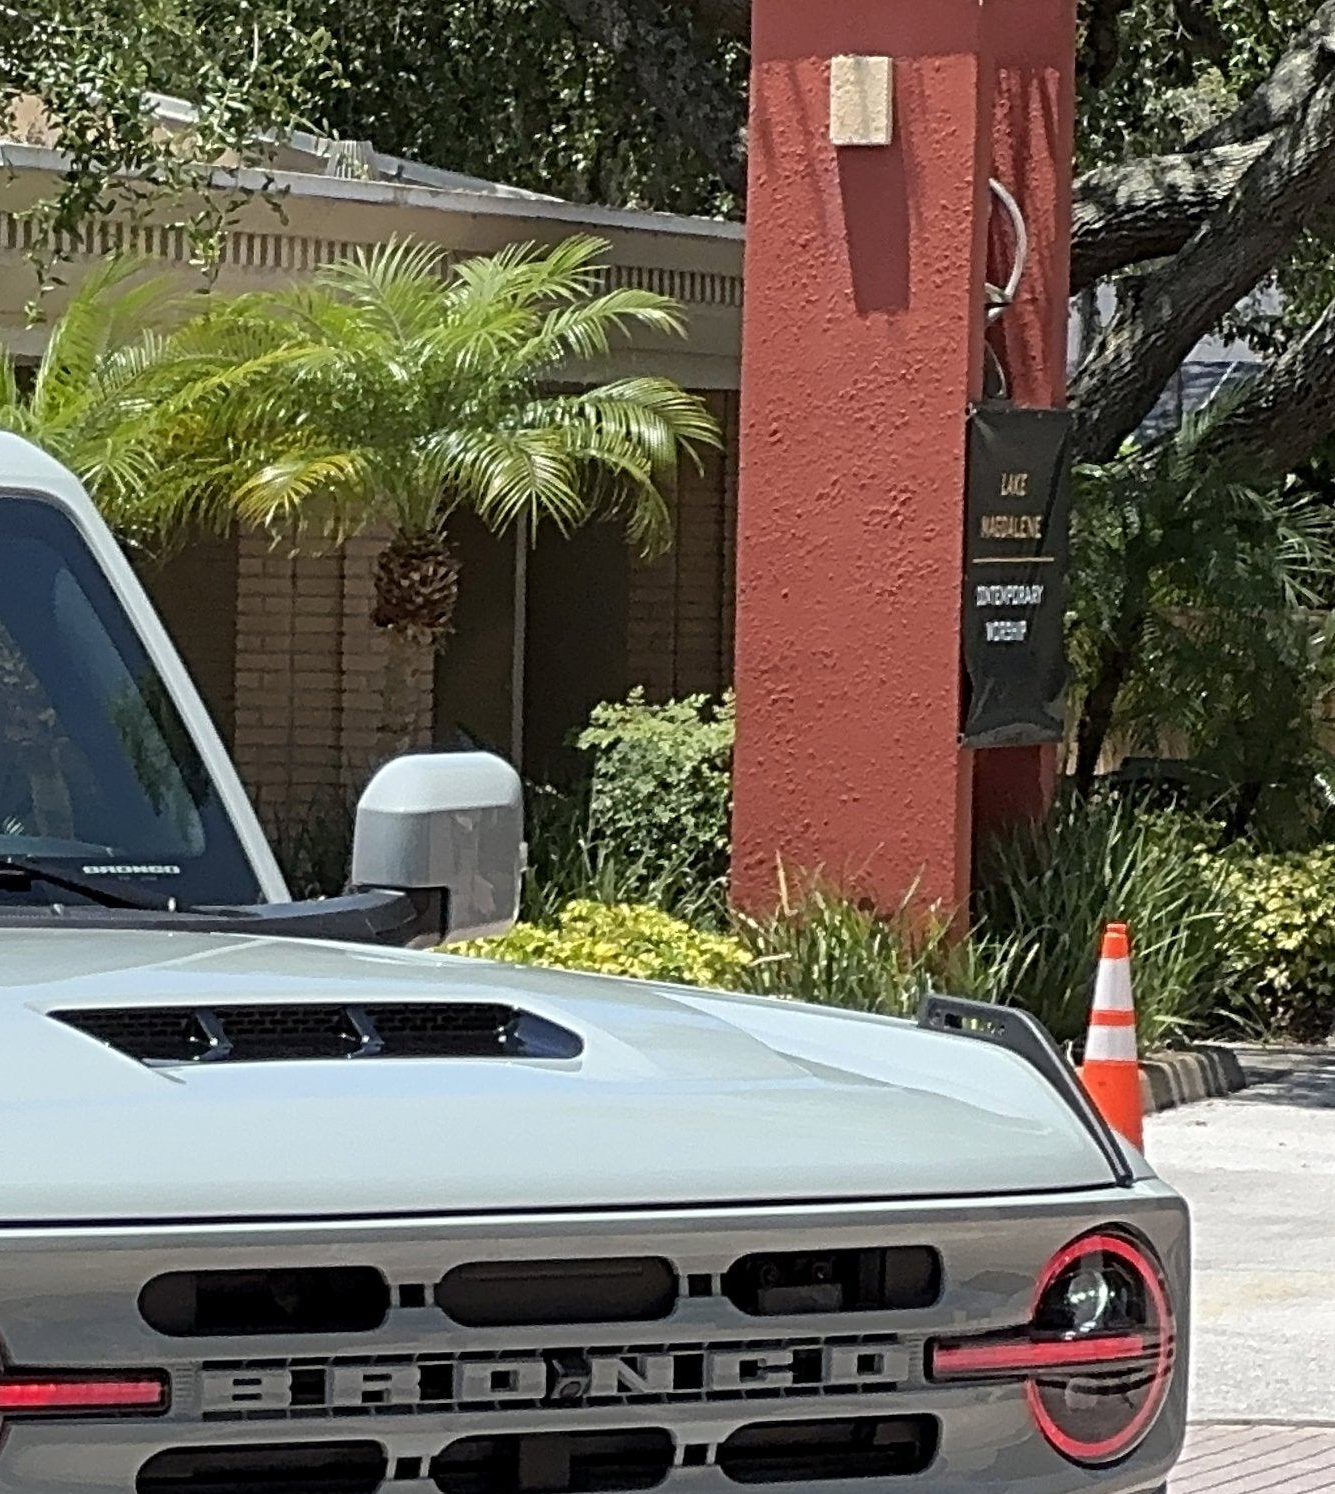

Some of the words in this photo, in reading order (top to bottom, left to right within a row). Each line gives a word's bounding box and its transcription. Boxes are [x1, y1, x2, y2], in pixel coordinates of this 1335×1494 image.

[1001, 473, 1028, 496] LAKE
[981, 515, 1042, 538] MAGDALENE
[82, 865, 180, 874] BRONCO
[202, 1342, 910, 1409] BRONCO
